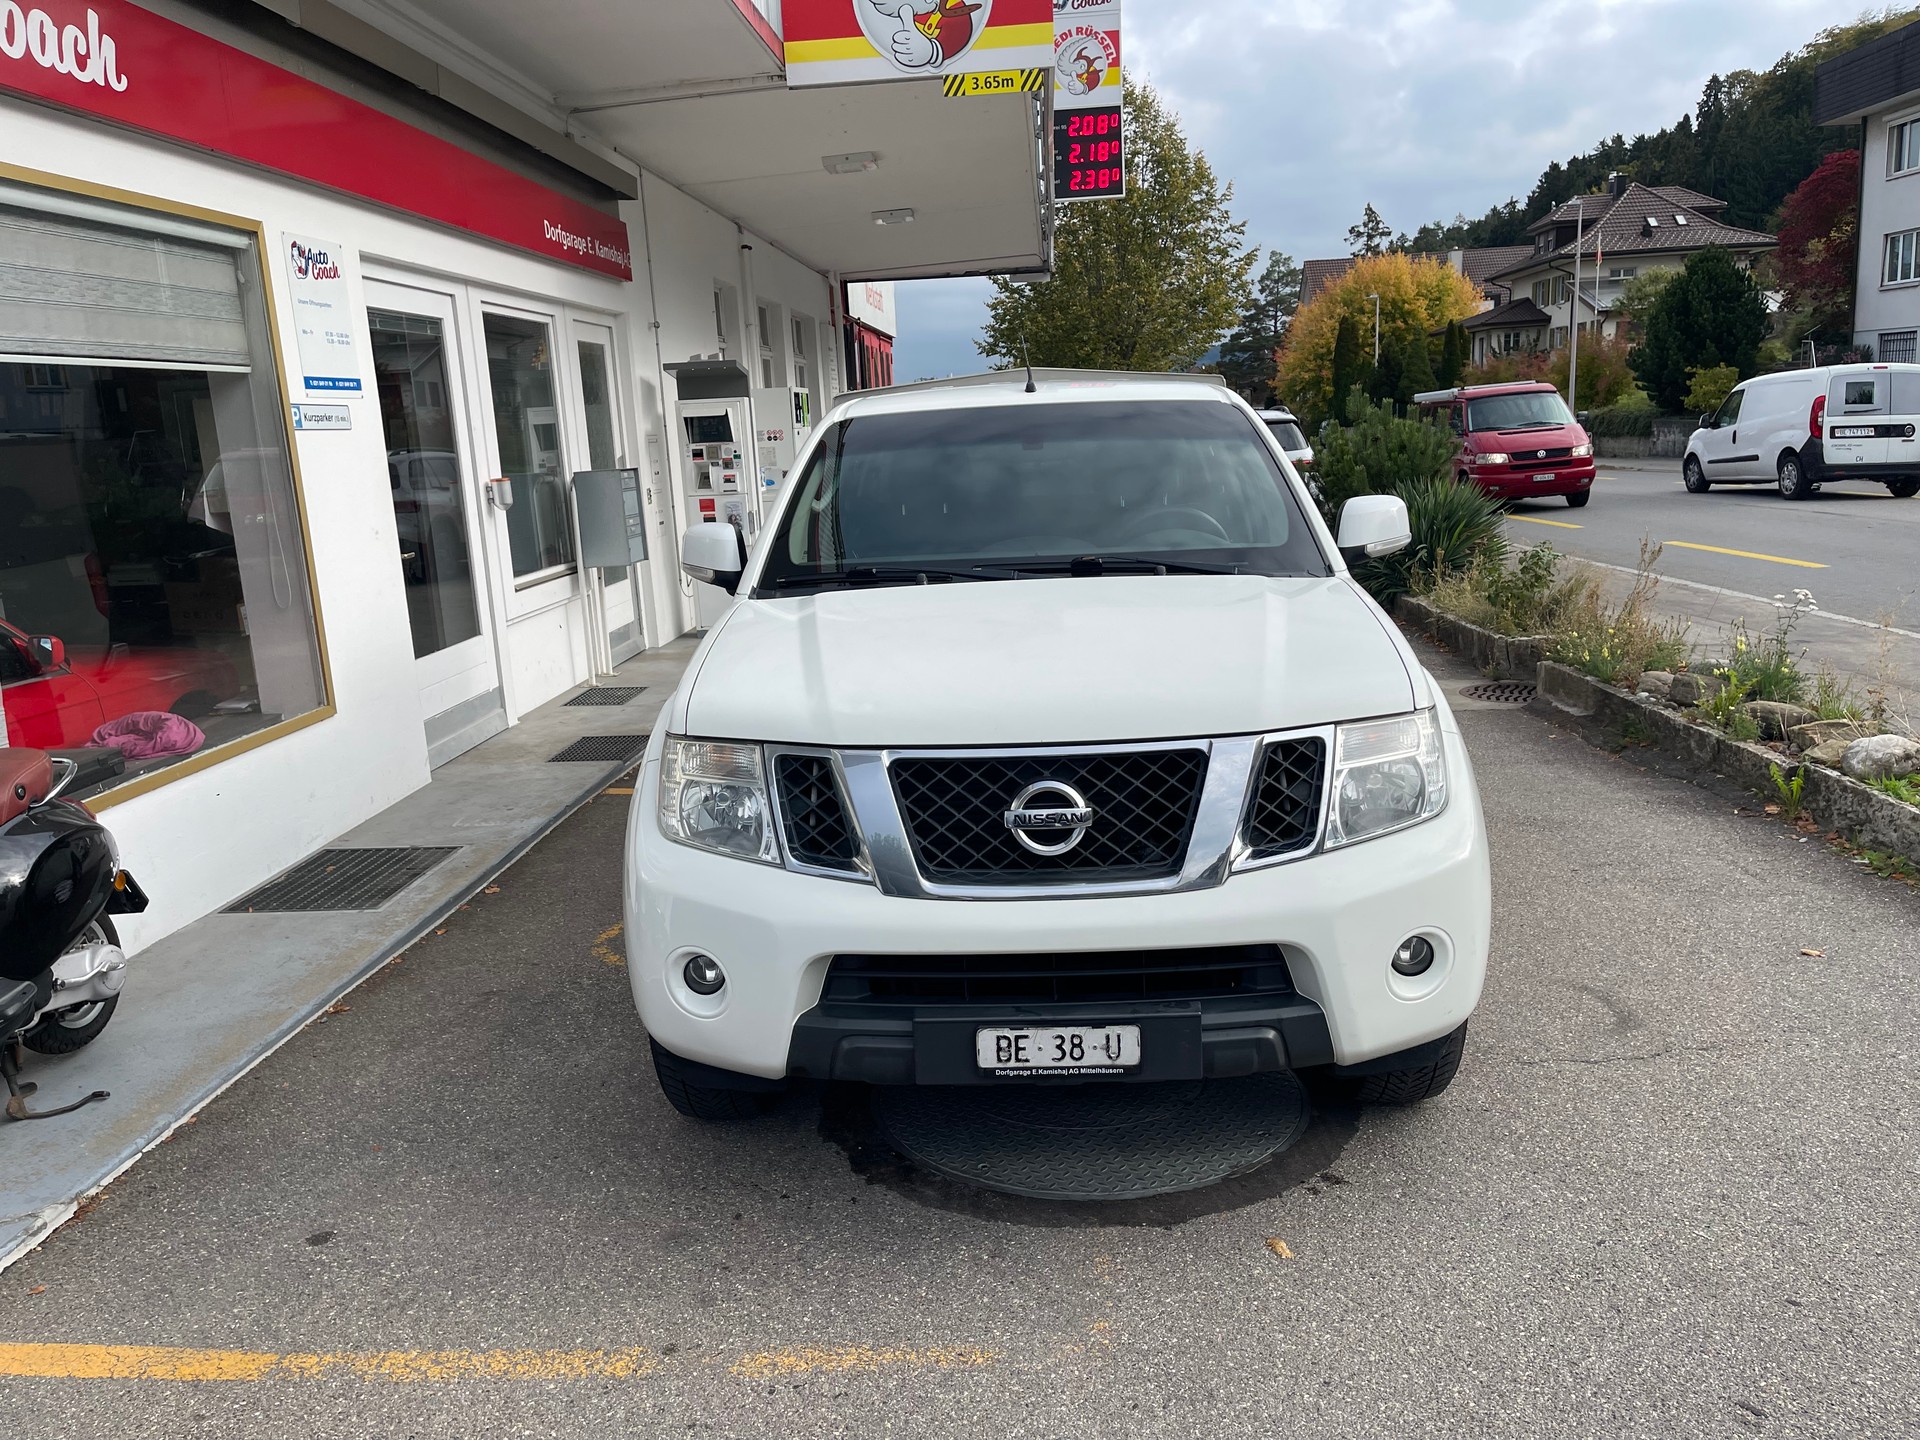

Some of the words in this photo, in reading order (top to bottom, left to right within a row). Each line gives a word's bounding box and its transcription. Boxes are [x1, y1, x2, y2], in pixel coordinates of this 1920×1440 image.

[0, 0, 128, 92] oach
[1075, 24, 1115, 61] RÜSSEL
[971, 76, 1015, 90] 3.65m
[543, 219, 587, 256] Dorfgarage
[587, 236, 595, 255] E.
[595, 239, 624, 269] Kamishaj
[306, 247, 329, 266] Auto
[311, 260, 341, 281] Coach
[303, 412, 334, 424] Kurzparker
[1014, 812, 1083, 825] NISSAN
[996, 1034, 1031, 1063] BE
[1051, 1033, 1085, 1062] 38
[1105, 1033, 1122, 1062] U
[995, 1069, 1031, 1077] Dorfgarage
